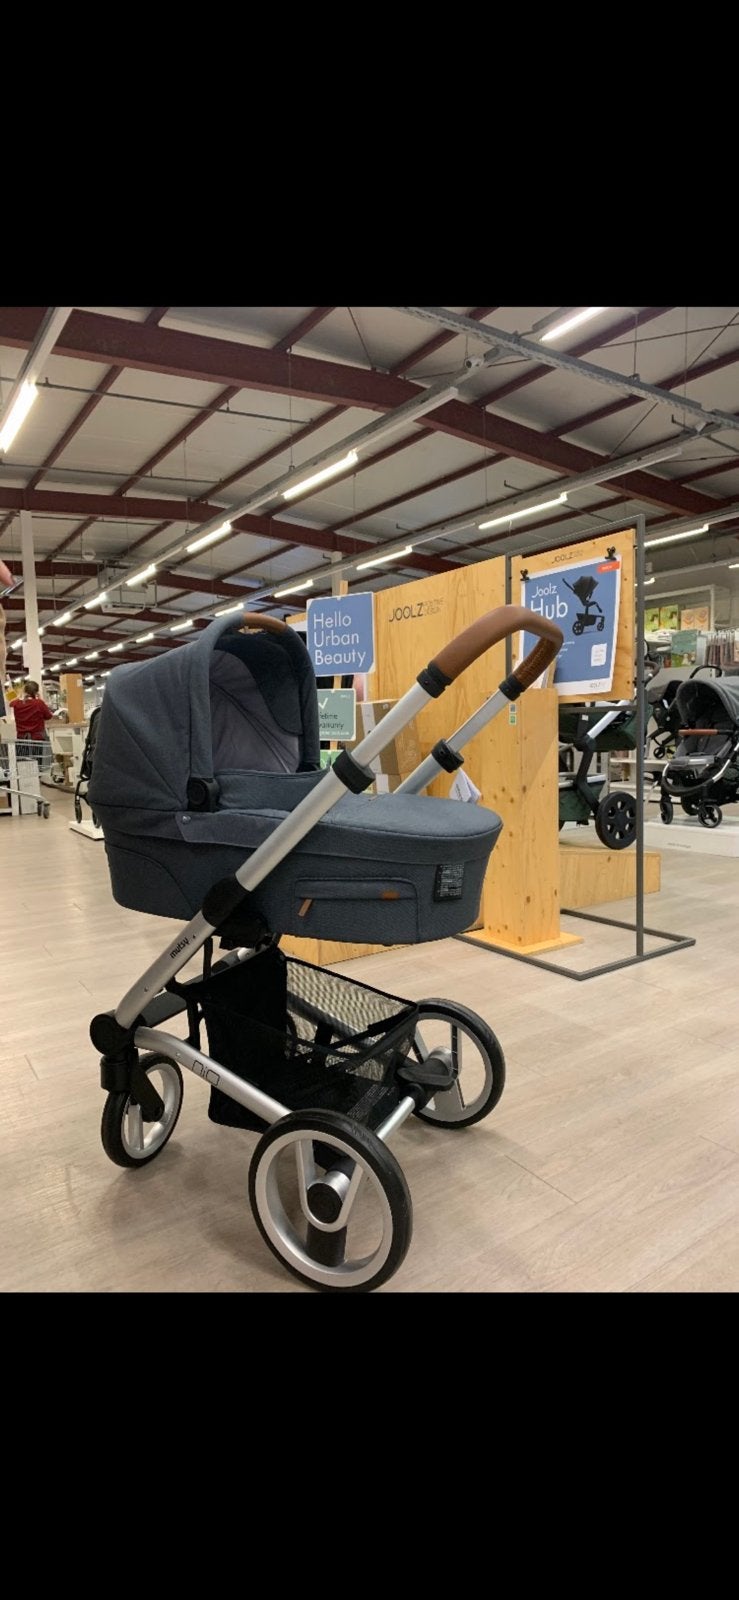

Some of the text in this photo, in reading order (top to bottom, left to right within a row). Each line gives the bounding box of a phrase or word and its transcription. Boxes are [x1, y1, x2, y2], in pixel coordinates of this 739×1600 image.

[531, 583, 558, 599] Joolz
[389, 602, 424, 623] JOOLZ
[530, 595, 568, 620] Hub
[313, 610, 352, 630] Hello
[313, 630, 360, 648] Urban
[314, 649, 367, 668] Beauty
[170, 936, 190, 958] mutsy
